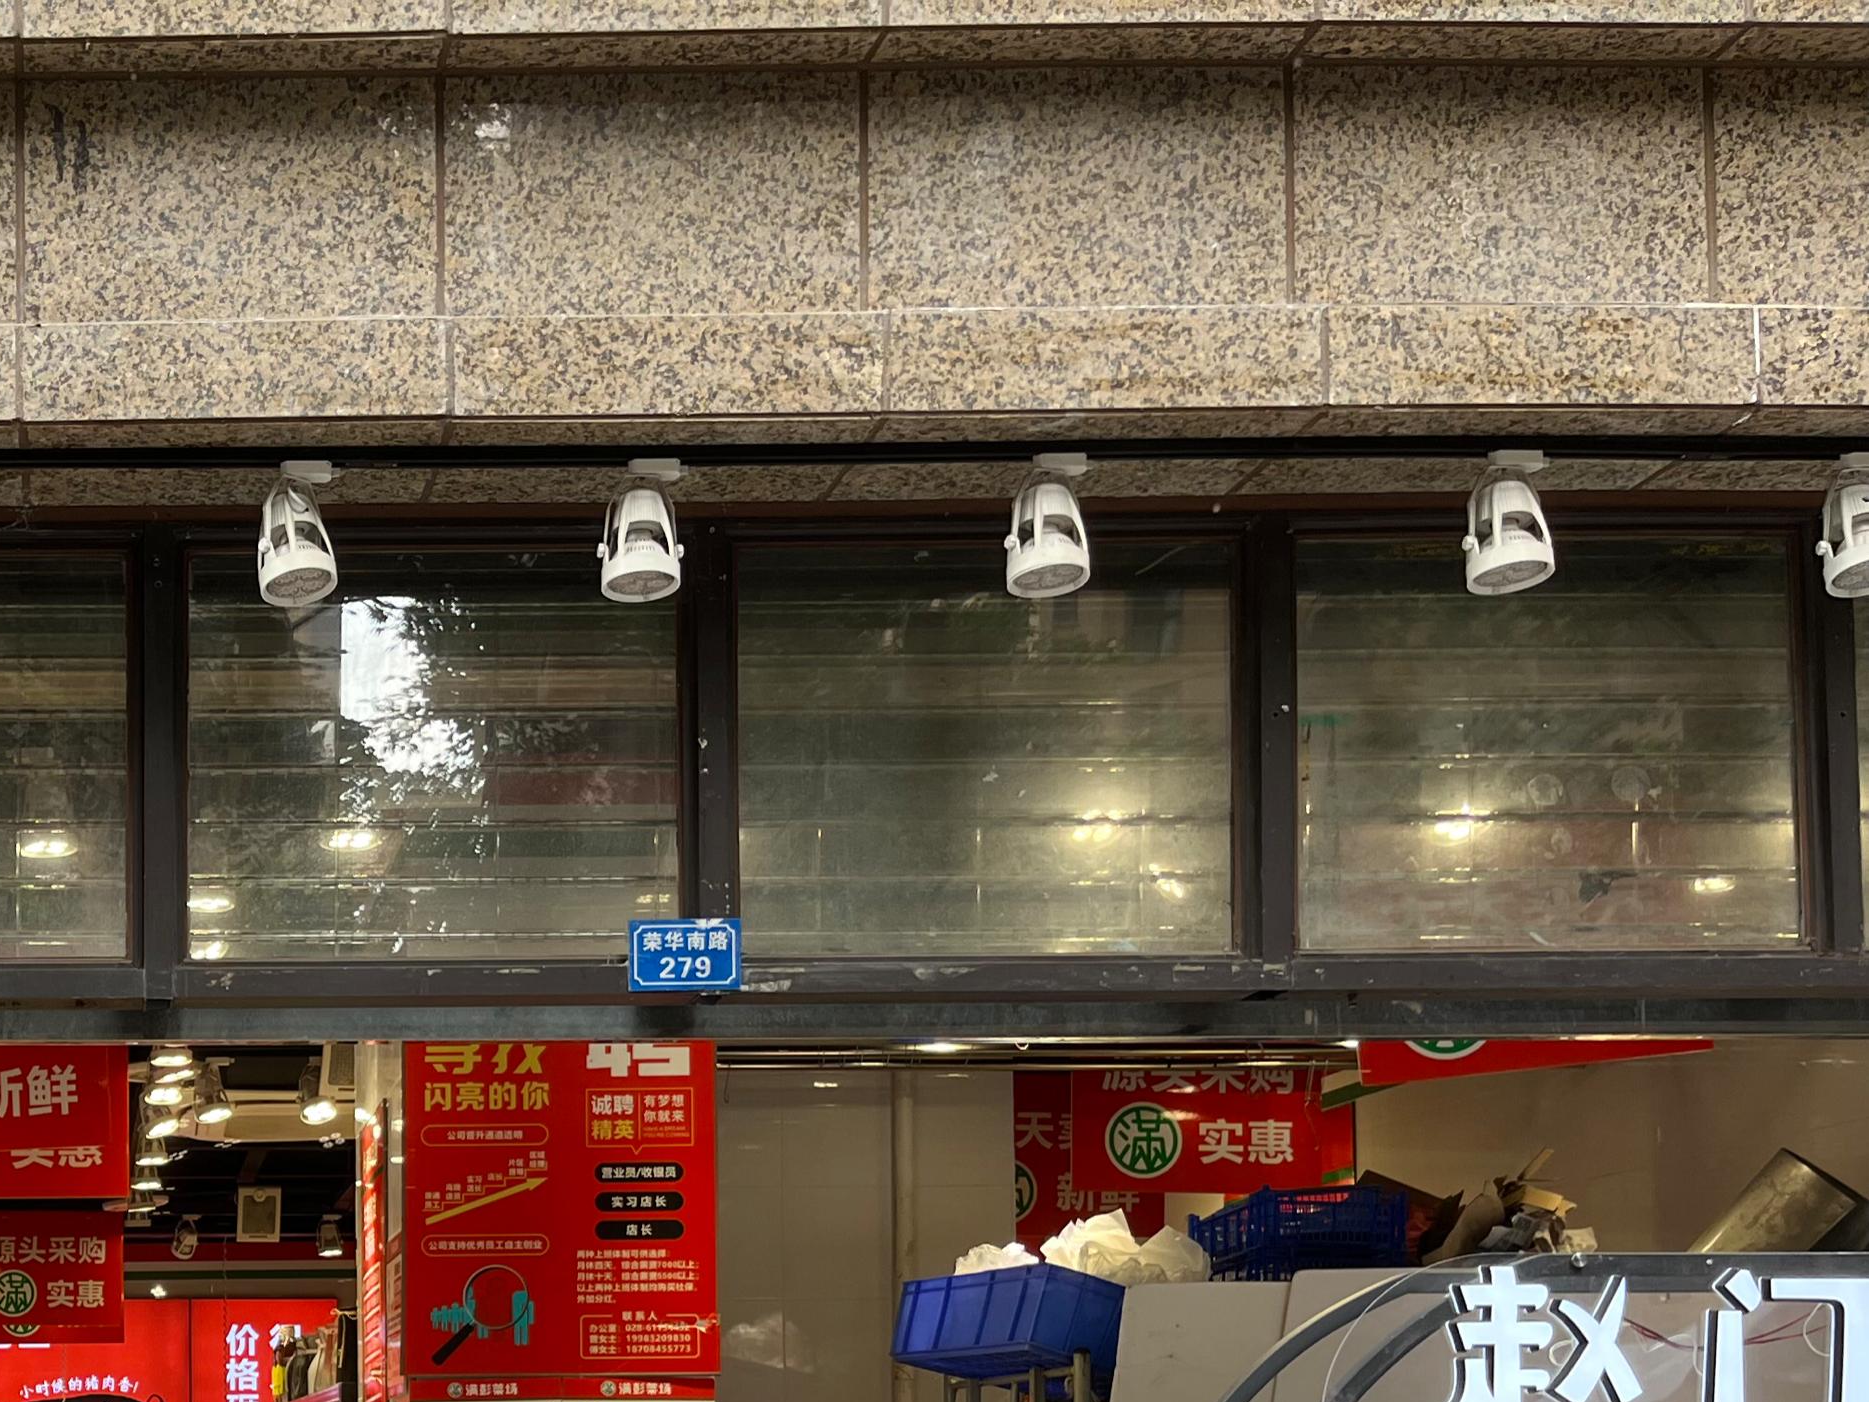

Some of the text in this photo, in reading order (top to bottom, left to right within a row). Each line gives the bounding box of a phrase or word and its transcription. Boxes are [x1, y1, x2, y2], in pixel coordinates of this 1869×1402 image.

[642, 930, 729, 952] 荣华南路
[659, 956, 711, 979] 279
[424, 1081, 551, 1112] 闪亮的你
[591, 1094, 685, 1116] 诚聘 有梦想
[591, 1110, 685, 1141] 精英 你就来
[1197, 1118, 1294, 1166] 实惠
[601, 1166, 677, 1179] 营业员/收银员
[611, 1195, 667, 1208] 实习店长
[626, 1224, 652, 1236] 店长
[46, 1279, 105, 1308] 实惠
[465, 1383, 518, 1396] 满彭菜场
[618, 1382, 672, 1396] 满彭菜场
